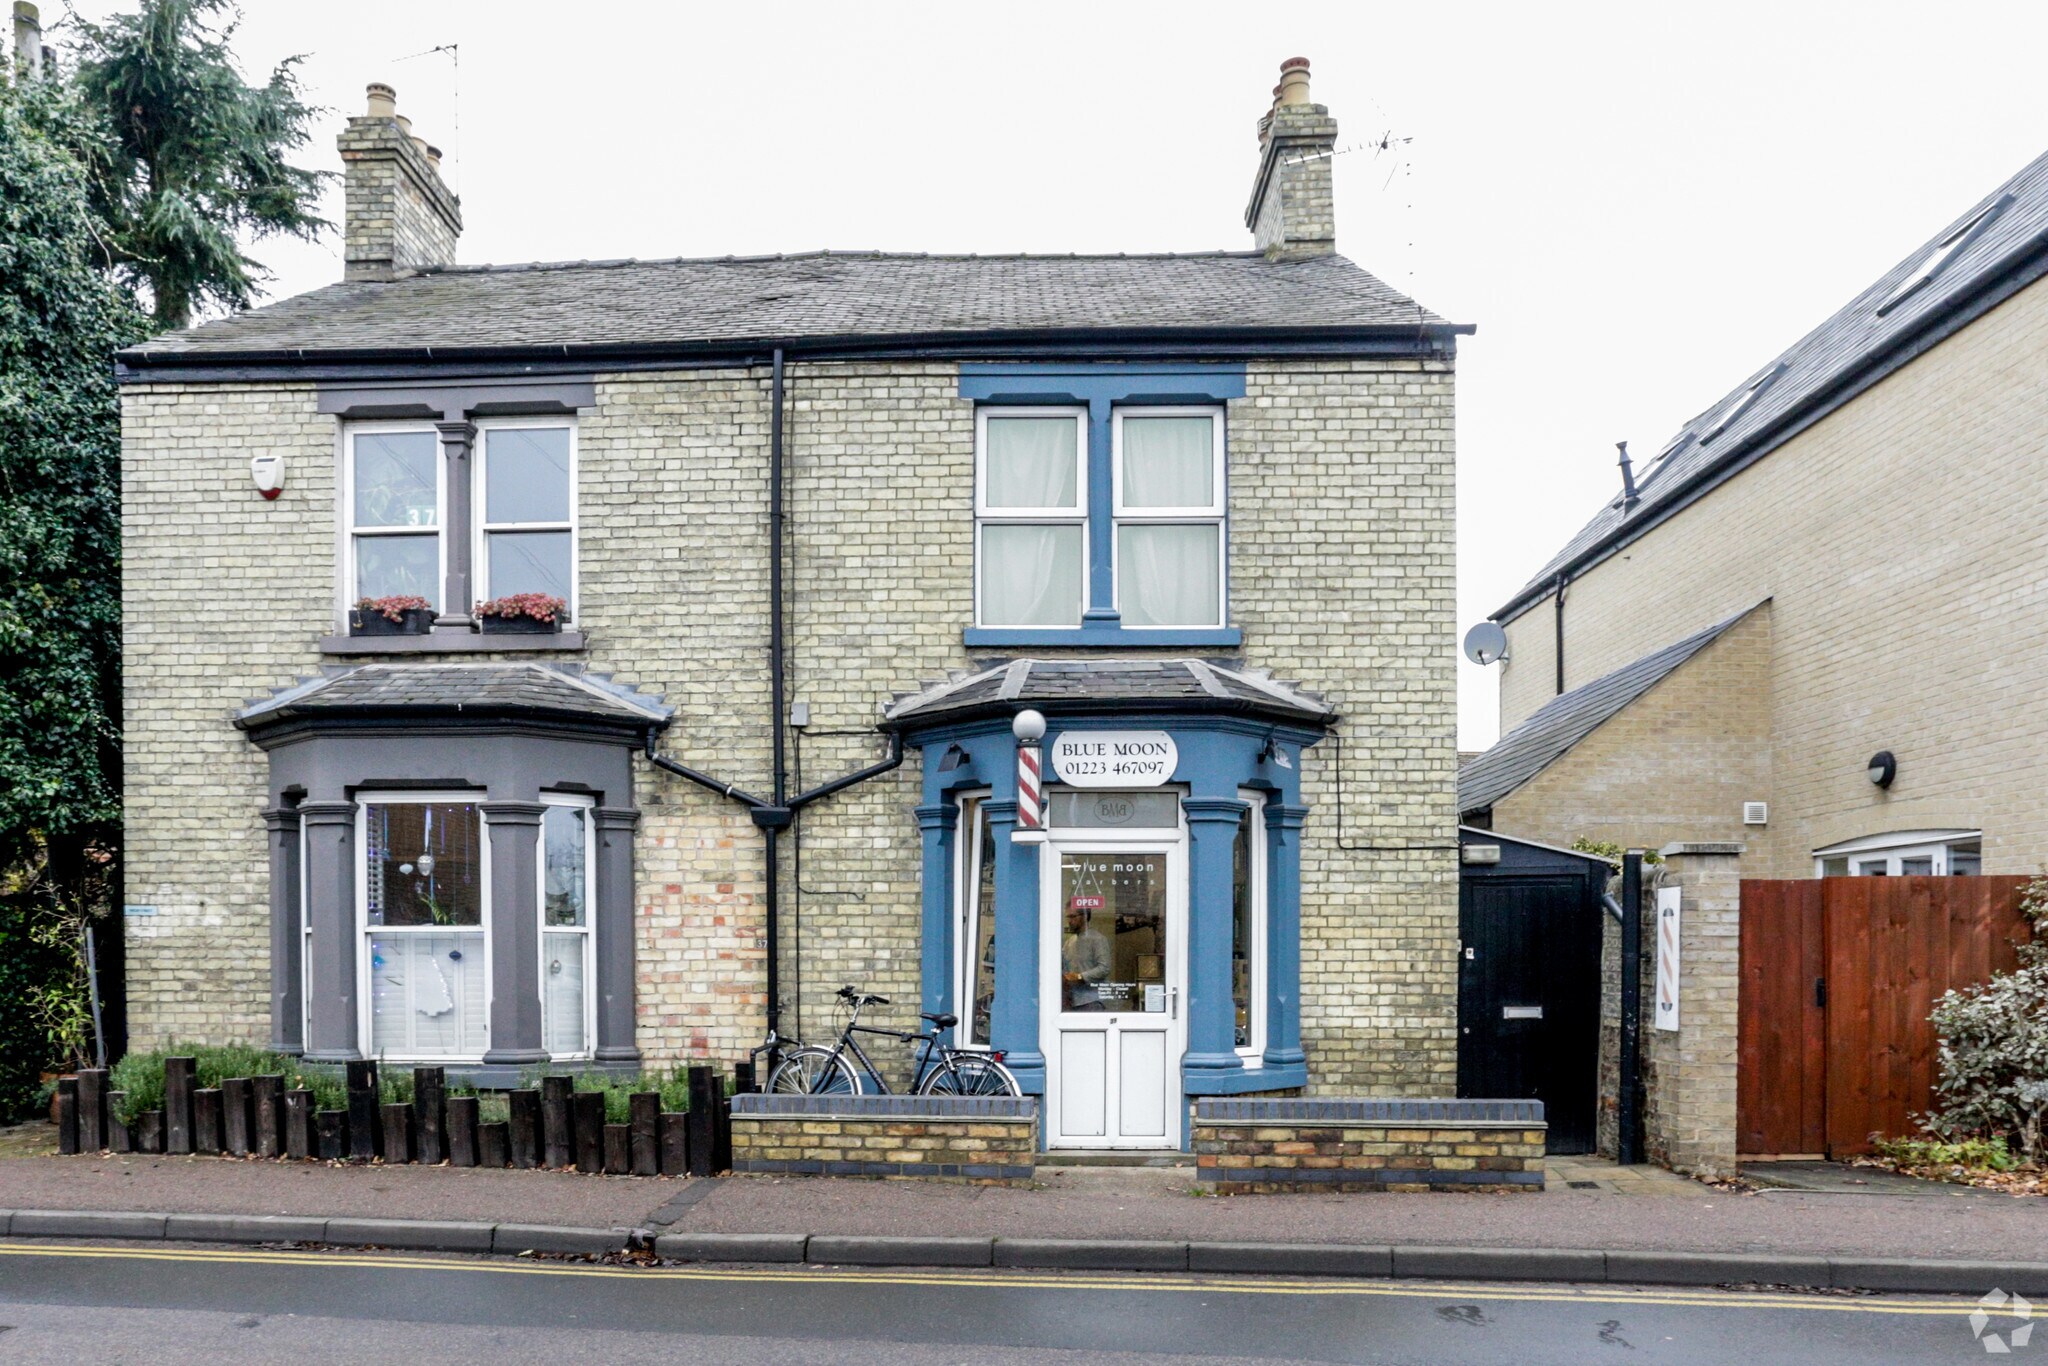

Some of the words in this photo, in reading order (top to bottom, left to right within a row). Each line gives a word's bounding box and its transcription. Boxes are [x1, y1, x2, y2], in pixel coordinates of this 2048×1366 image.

[409, 509, 435, 526] 37
[1062, 743, 1106, 756] BLUE
[1113, 743, 1168, 757] MOON
[1065, 762, 1107, 775] 01223
[1112, 761, 1164, 775] 467097
[1073, 862, 1107, 872] blue
[1113, 863, 1154, 872] moon
